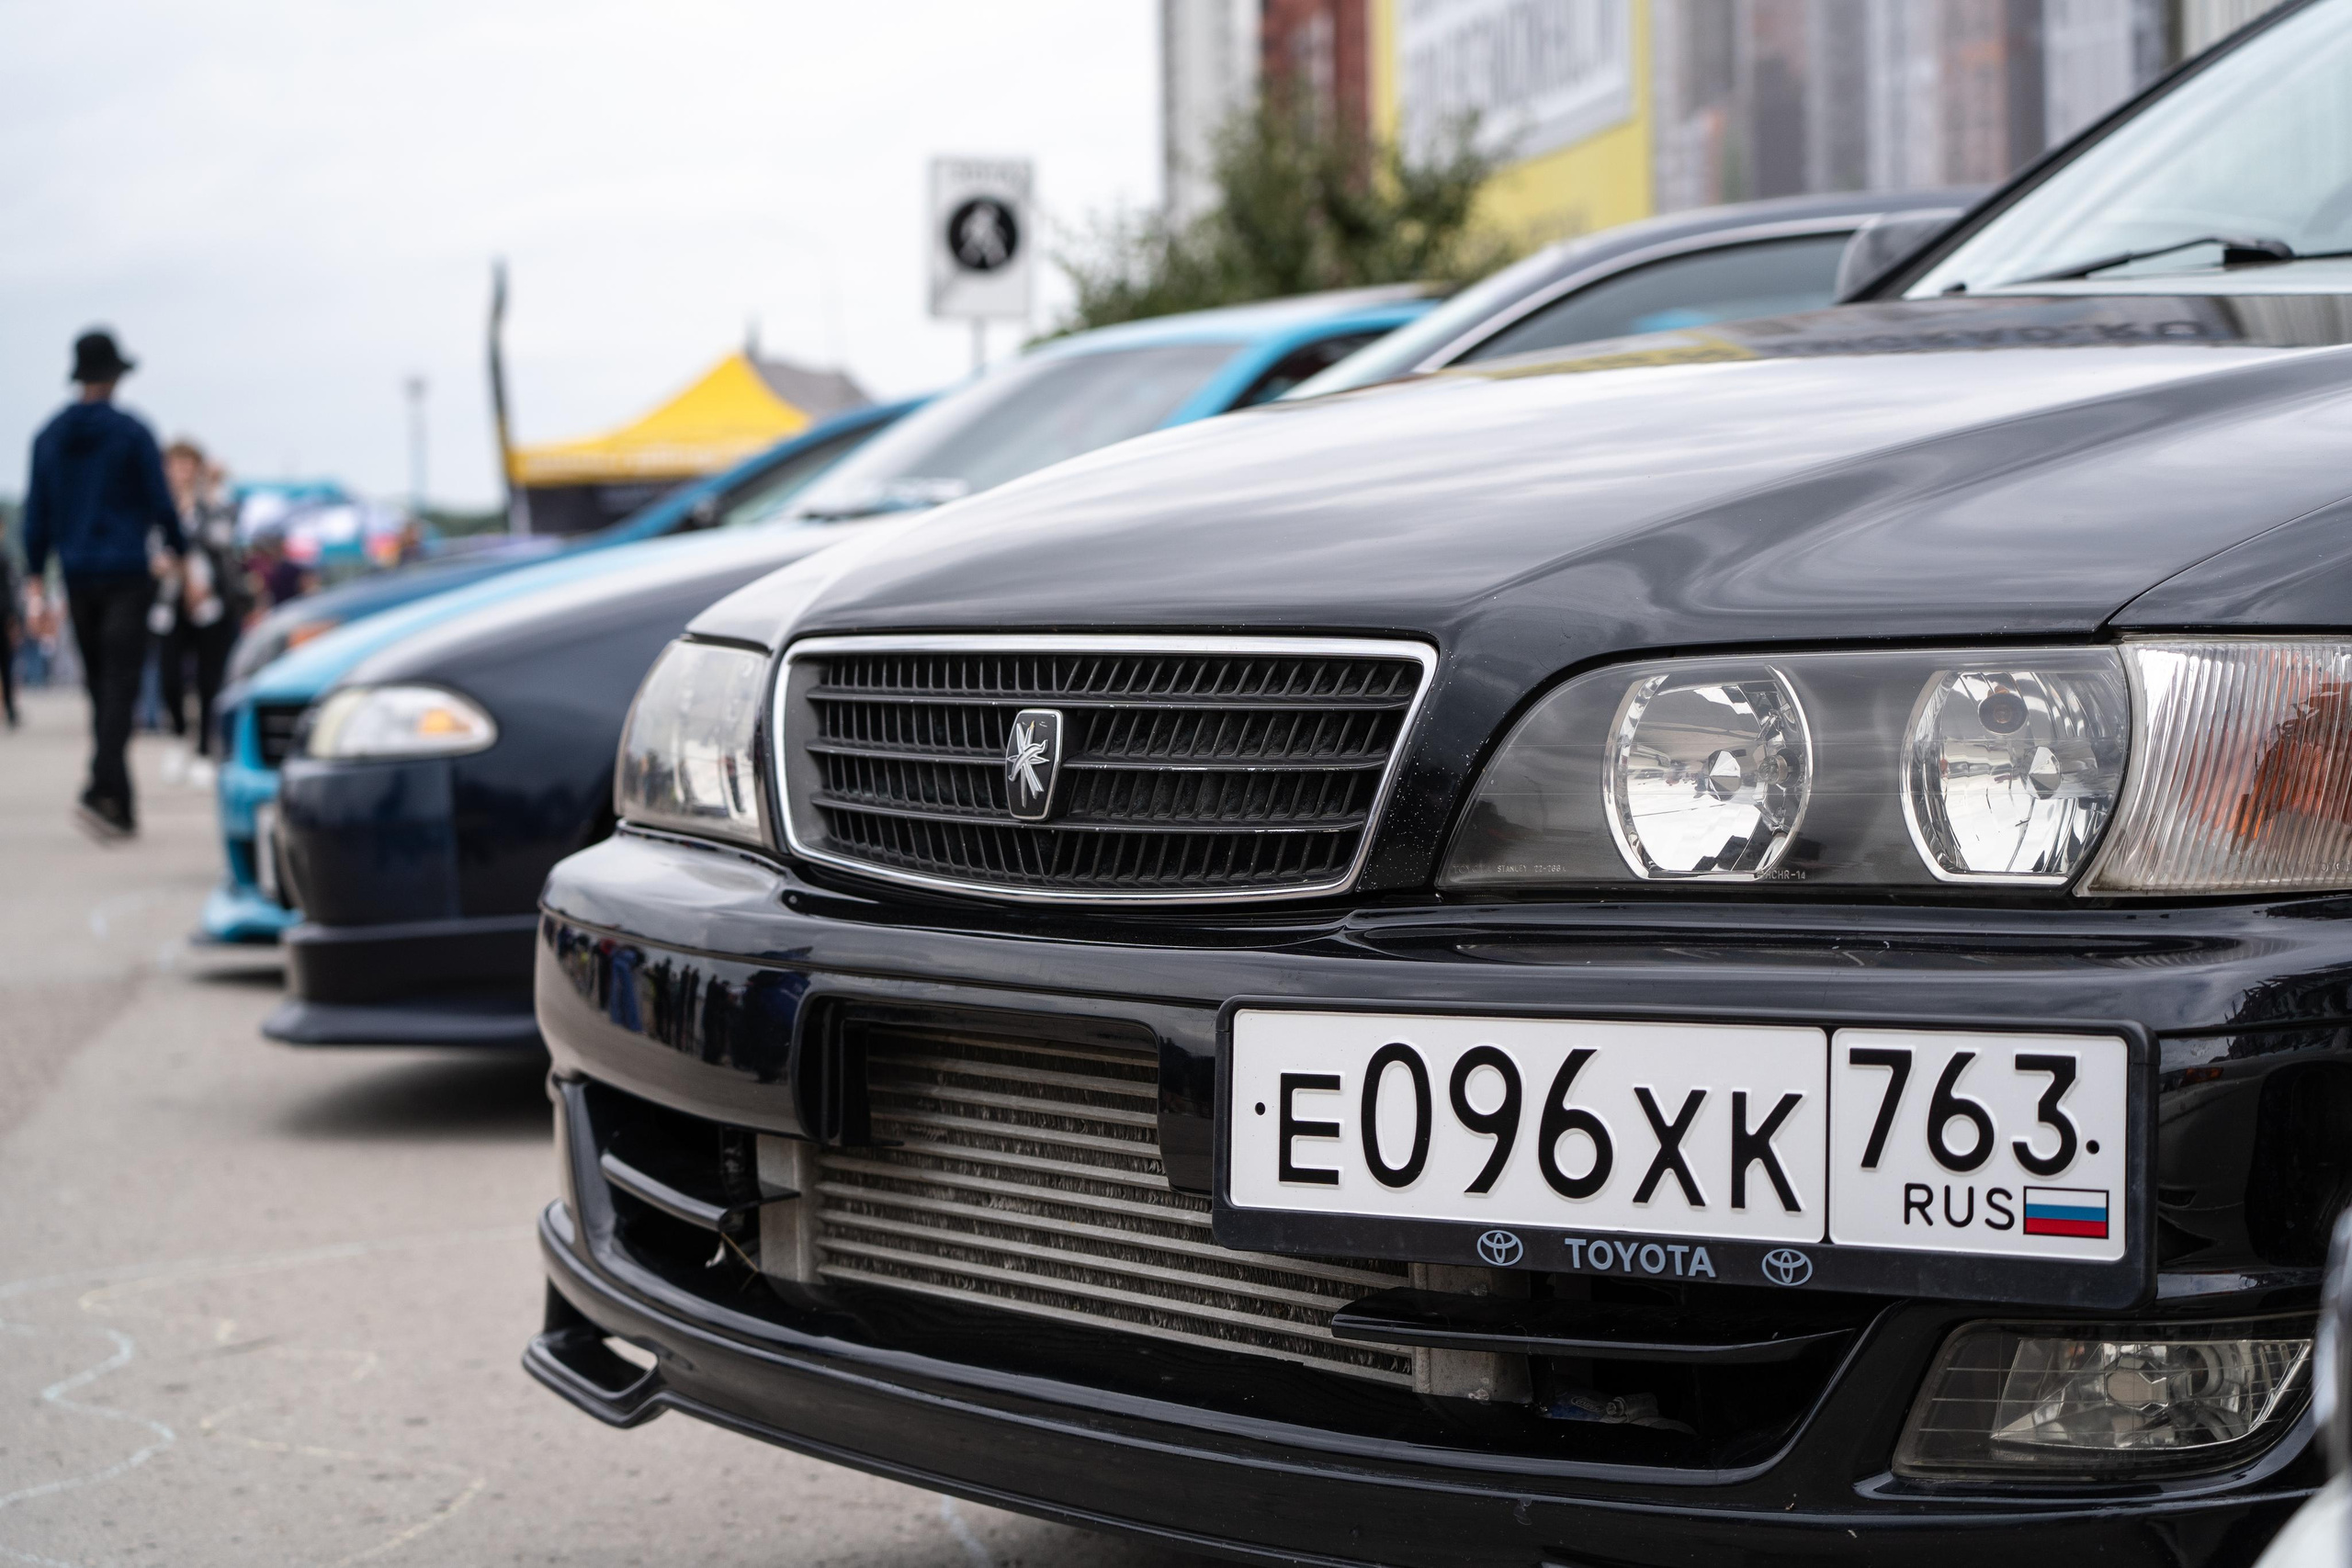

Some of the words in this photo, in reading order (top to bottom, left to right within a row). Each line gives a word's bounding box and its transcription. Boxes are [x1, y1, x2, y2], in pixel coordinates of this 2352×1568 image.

[1497, 864, 1527, 873] STANLEY
[1849, 1048, 2077, 1176] 763
[1904, 1182, 2015, 1231] RUS
[1565, 1237, 1716, 1278] TOYOTA
